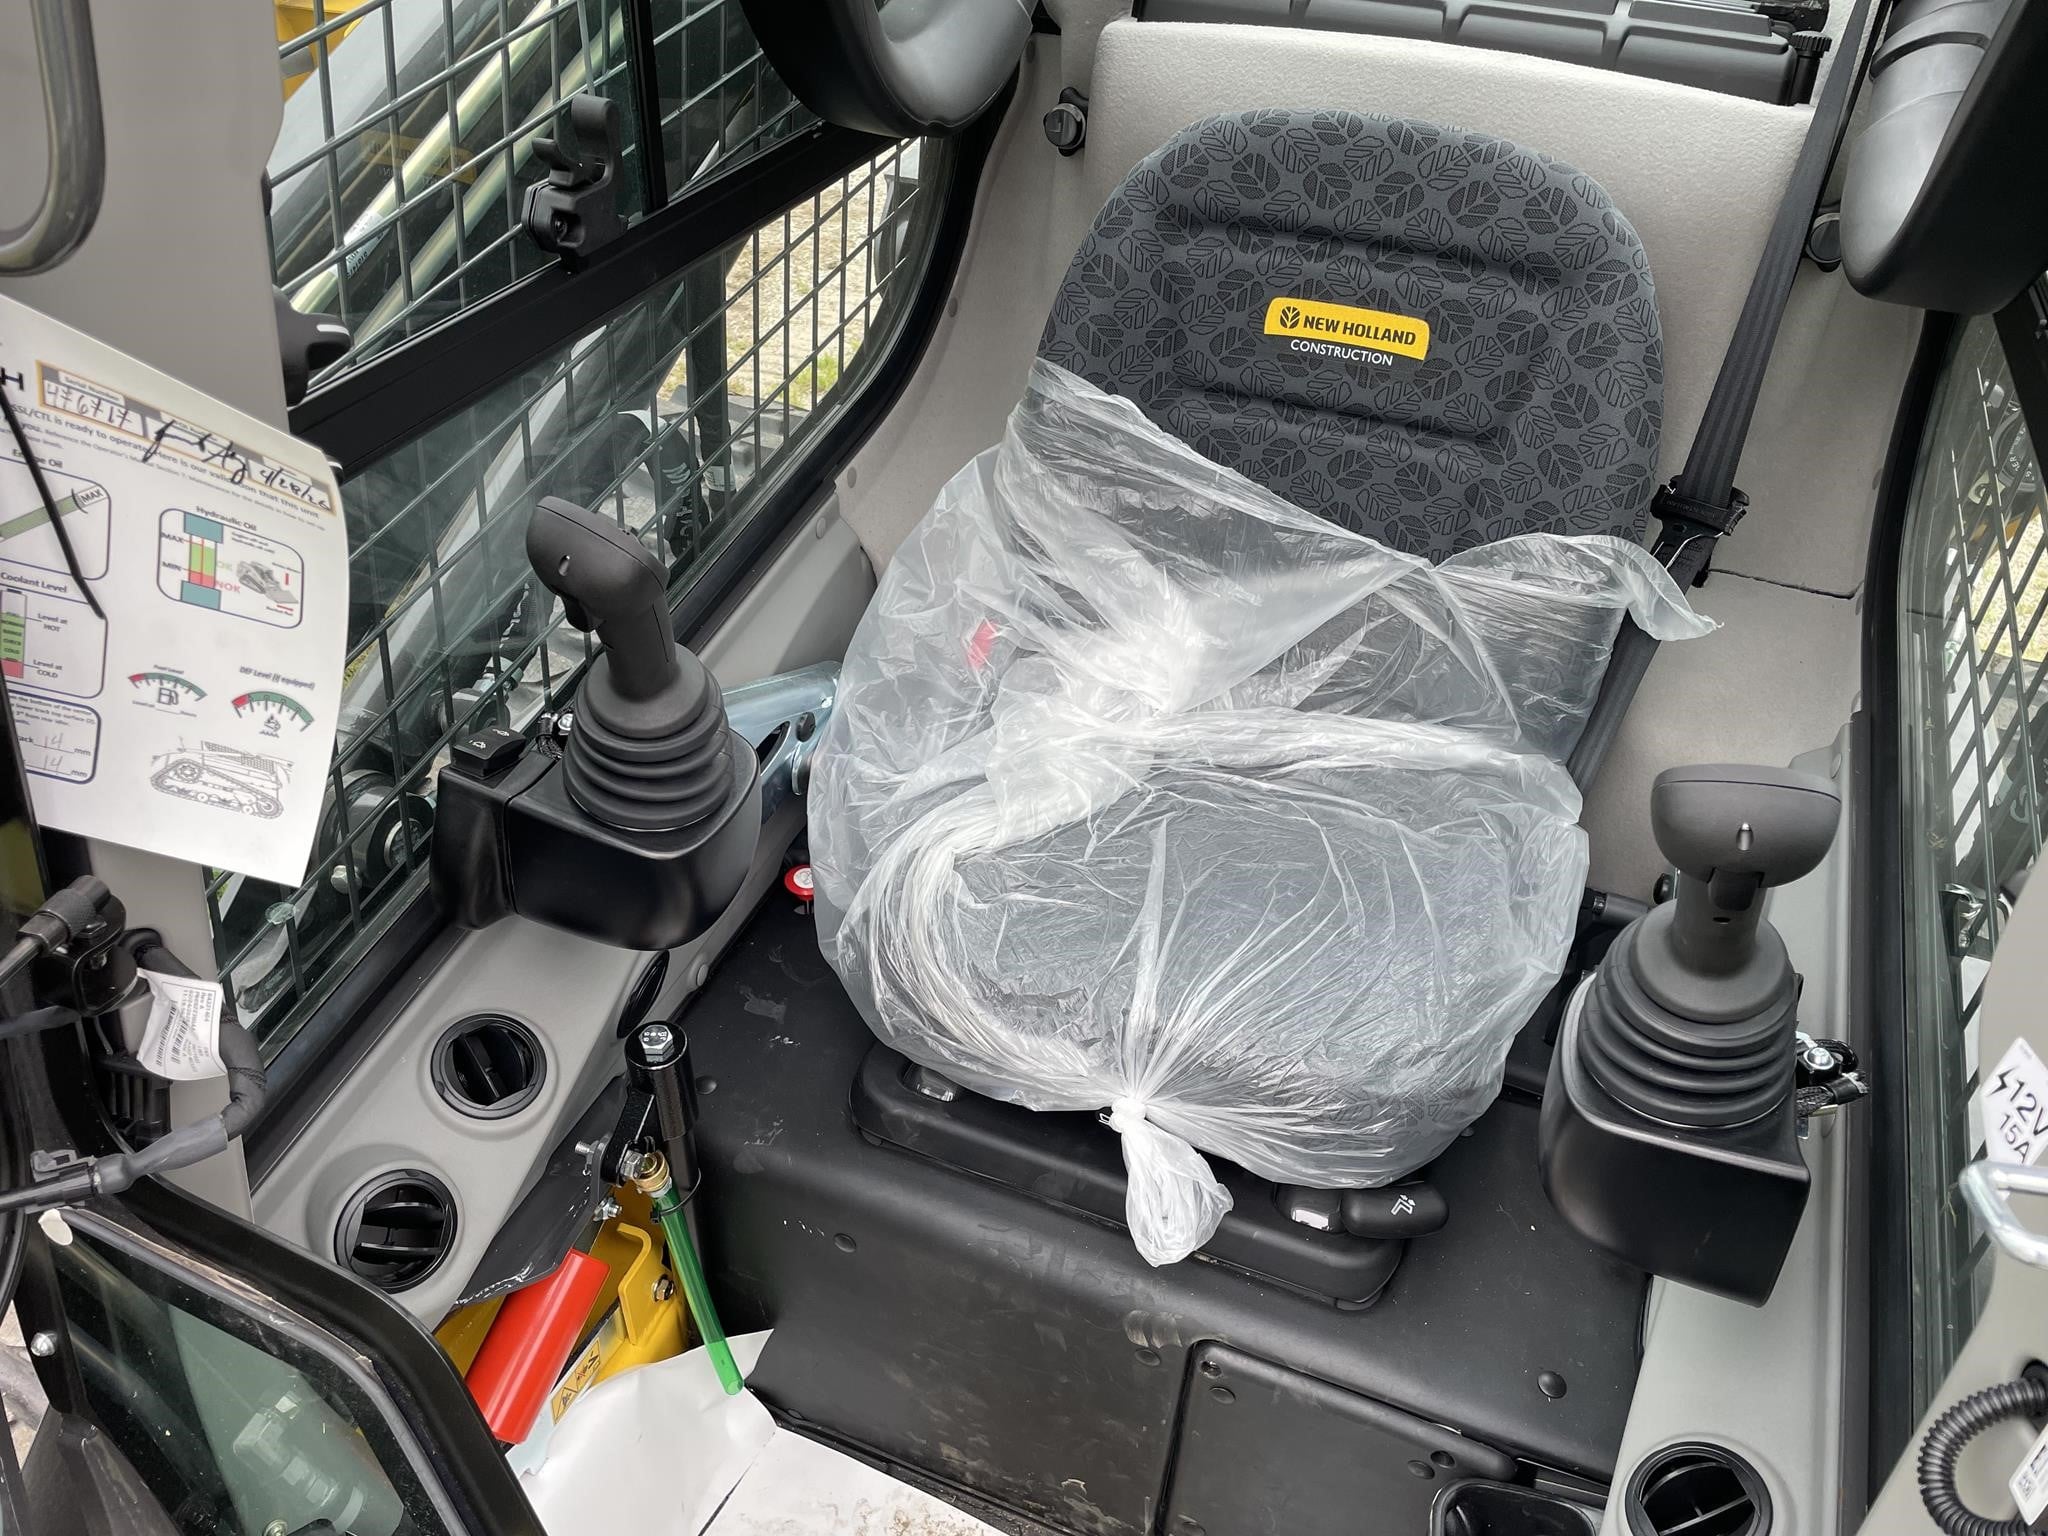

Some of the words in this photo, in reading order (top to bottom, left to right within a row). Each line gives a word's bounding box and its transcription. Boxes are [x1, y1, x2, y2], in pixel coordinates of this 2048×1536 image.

[1303, 314, 1341, 333] NEW
[1342, 321, 1416, 346] HOLLAND
[1290, 339, 1394, 366] CONSTRUCTION
[48, 458, 63, 468] Oil
[64, 420, 94, 438] ready
[96, 430, 107, 440] to
[259, 489, 279, 502] that
[280, 498, 299, 511] this
[80, 488, 104, 503] MAX
[195, 505, 242, 527] Hydraulic
[243, 521, 257, 531] Oil
[161, 532, 185, 544] MAX
[1, 571, 40, 587] Coolant
[41, 580, 68, 593] Level
[215, 580, 242, 594] NOK
[37, 669, 59, 679] COLD
[239, 665, 253, 675] DEF
[253, 669, 272, 680] Level
[74, 747, 92, 756] mm
[2009, 1079, 2048, 1137] 12V
[1999, 1113, 2031, 1165] 15A
